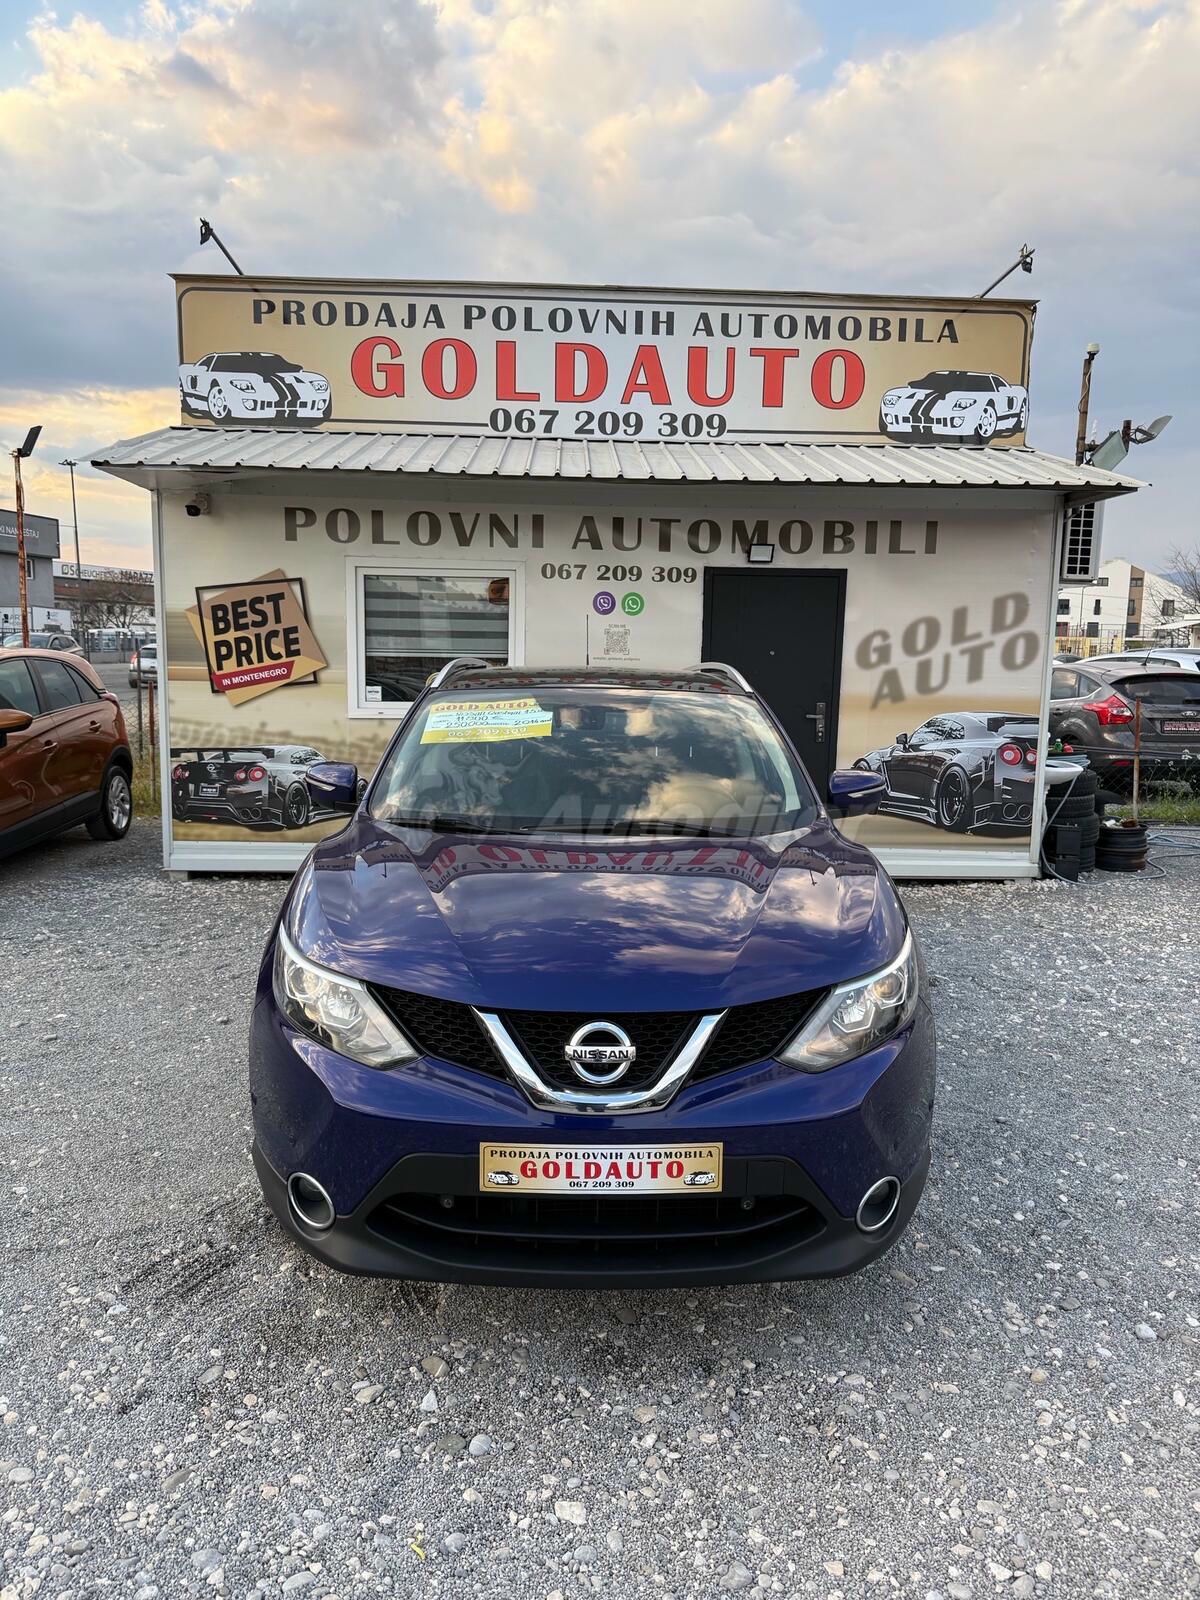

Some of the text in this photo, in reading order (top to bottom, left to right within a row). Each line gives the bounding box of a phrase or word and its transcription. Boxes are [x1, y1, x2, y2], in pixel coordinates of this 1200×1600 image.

[252, 299, 959, 344] PRODAJA POLOVNIH AUTOMOBILA
[350, 335, 866, 410] GOLDAUTO
[489, 408, 727, 438] 067 209 309
[284, 506, 938, 555] POLOVNI AUTOMOBILI
[541, 563, 698, 584] 067 209 309
[210, 592, 285, 636] BEST
[855, 591, 1030, 671] GOLD
[213, 626, 302, 672] PRICE
[232, 667, 288, 684] MONTENEGRO
[869, 630, 1041, 710] AUTO
[435, 701, 529, 712] GOLD AUTO
[572, 1049, 629, 1060] NISSAN
[490, 1150, 714, 1161] PRODAJA POLOVNIH AUTOMOBILA
[520, 1160, 685, 1180] GOLDAUTO
